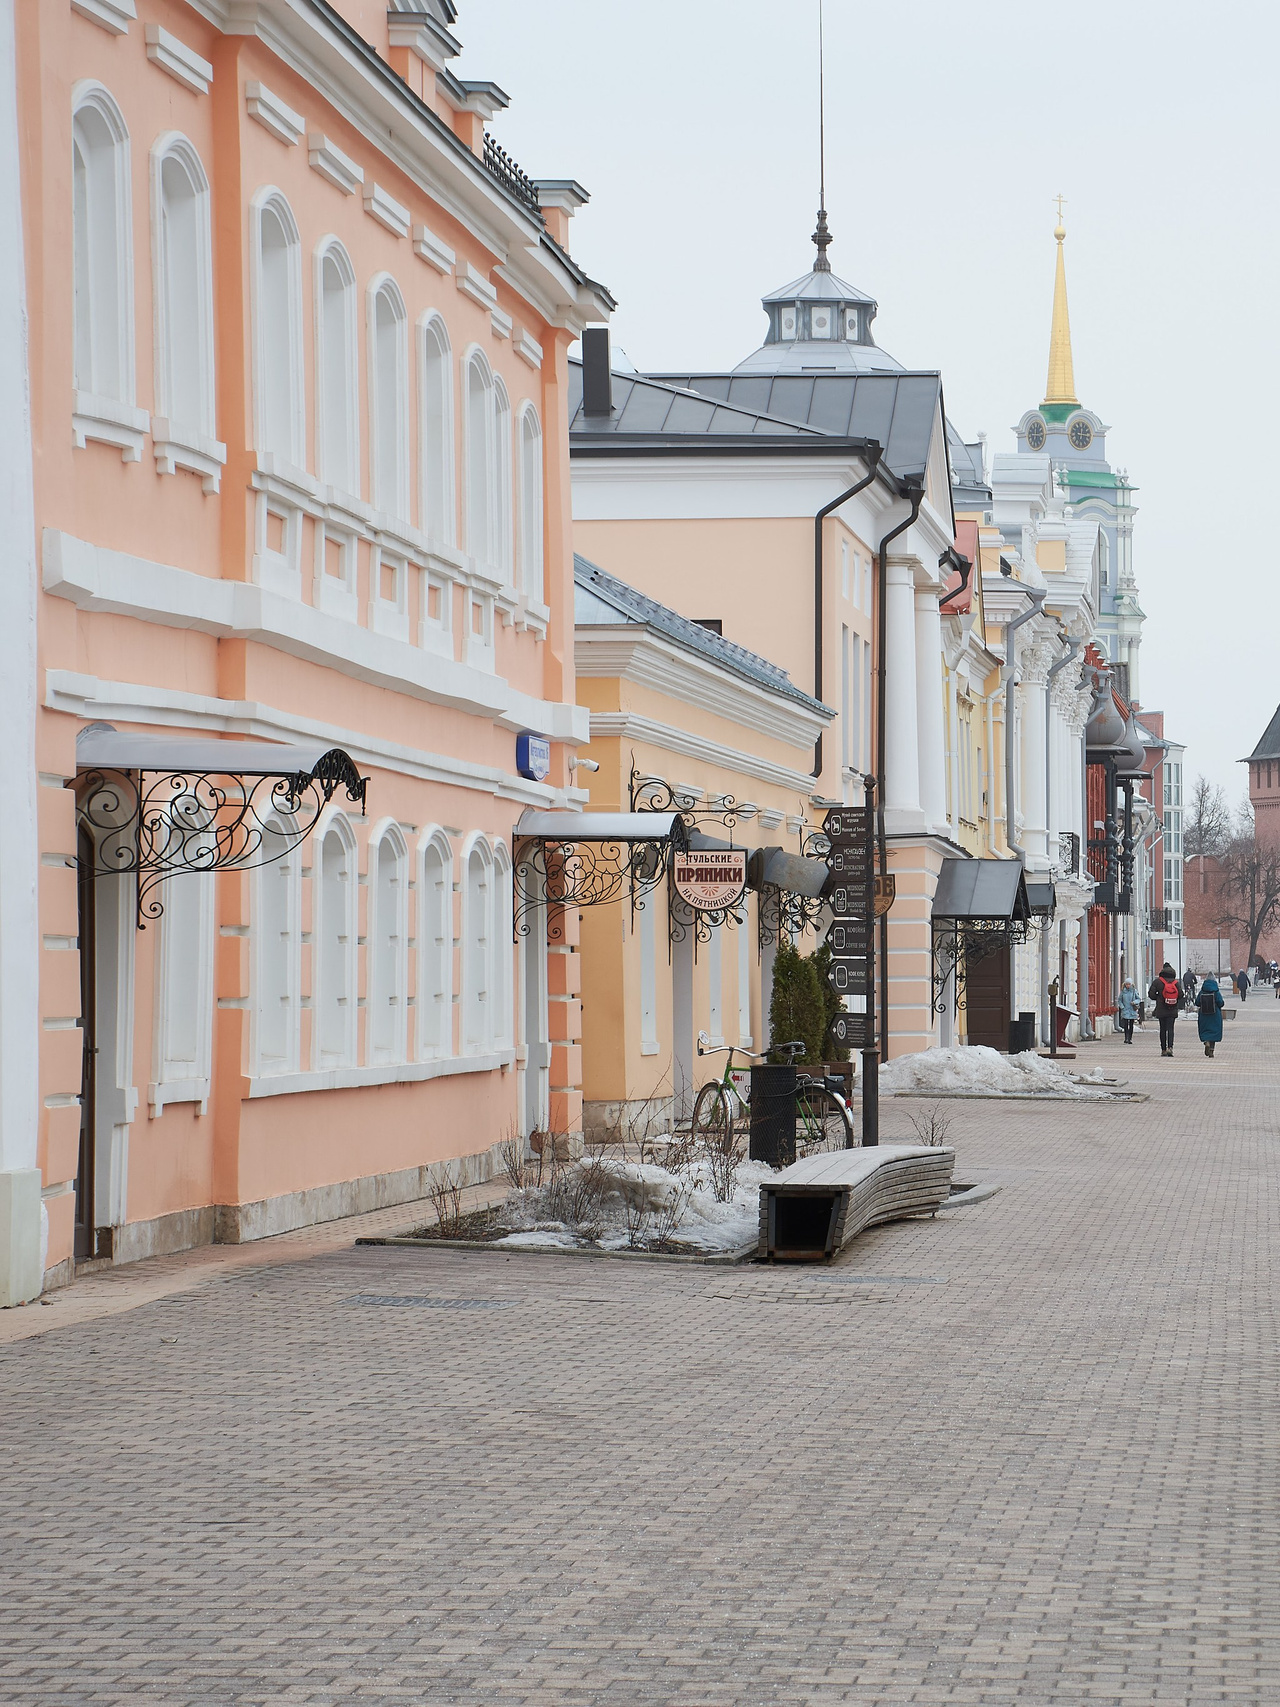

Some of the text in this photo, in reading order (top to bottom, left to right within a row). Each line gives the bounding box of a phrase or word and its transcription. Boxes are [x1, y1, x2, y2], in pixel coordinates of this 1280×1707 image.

[688, 855, 732, 863] ТУЛЬСКИЕ
[677, 867, 743, 882] ПРЯНИКИ
[682, 888, 738, 908] НА ПЯТНИЦКОЙ
